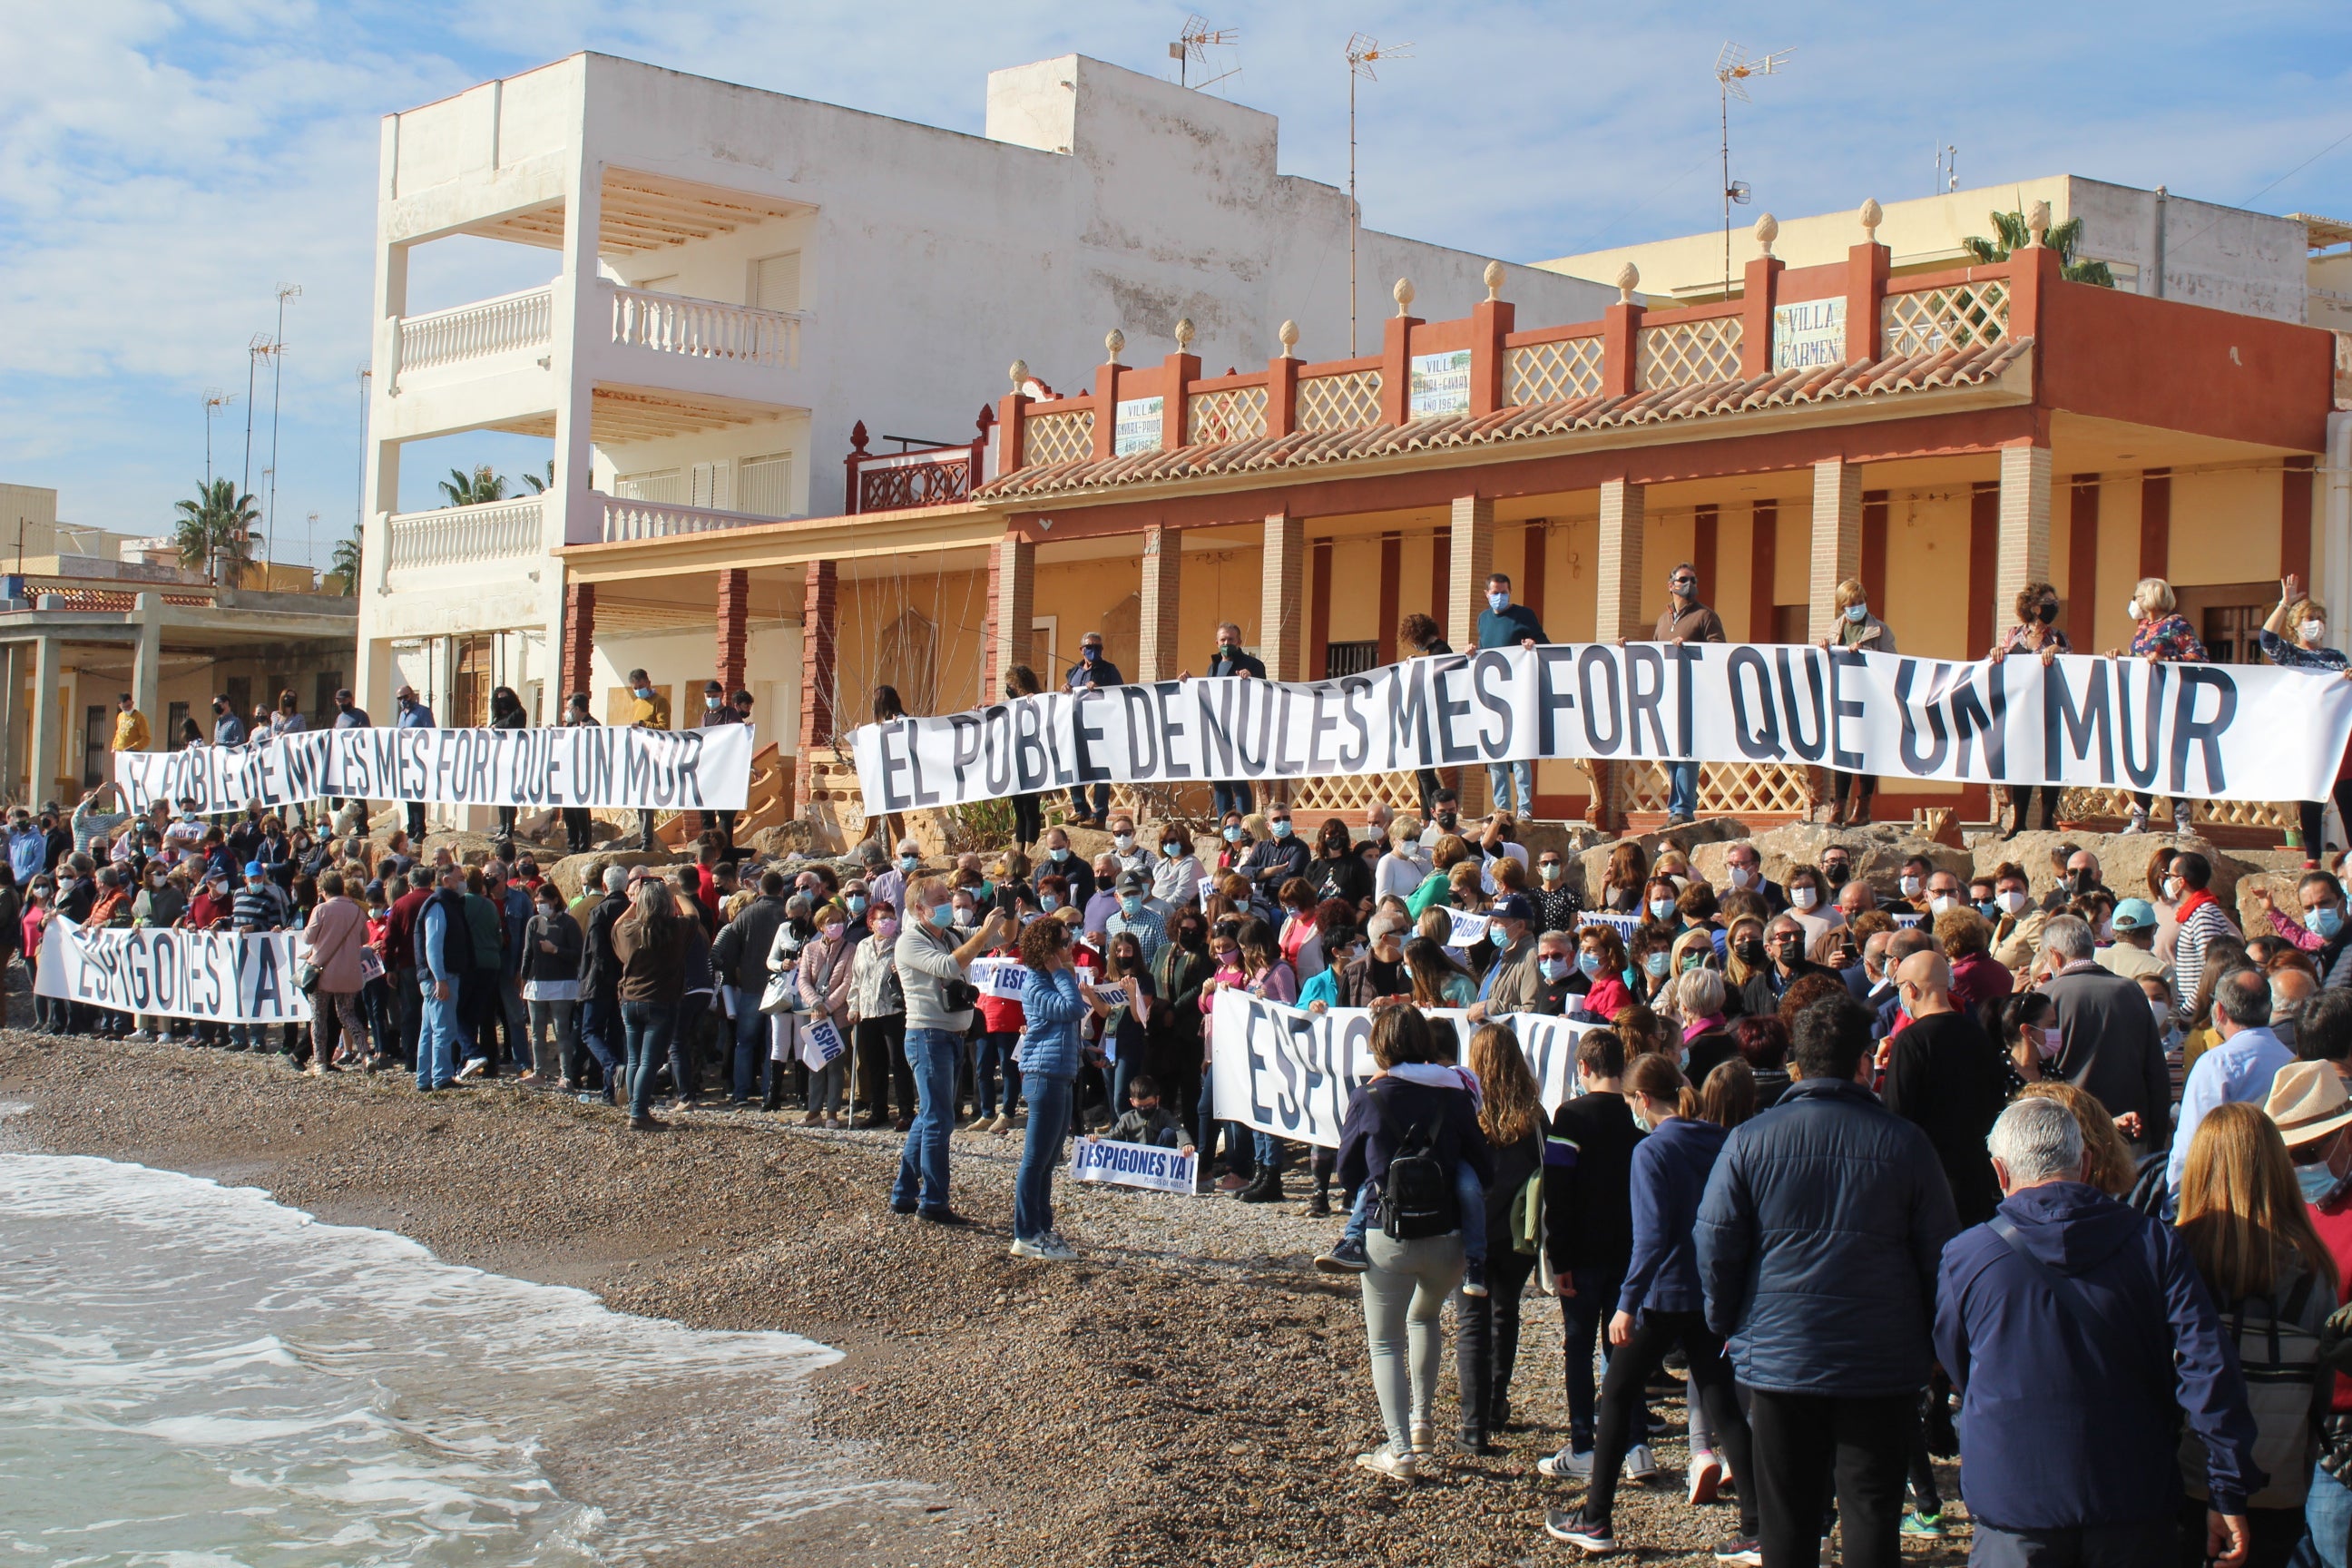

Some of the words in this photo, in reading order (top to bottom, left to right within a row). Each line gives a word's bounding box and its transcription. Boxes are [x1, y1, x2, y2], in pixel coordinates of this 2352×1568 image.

[1788, 303, 1836, 332] VILLA
[1426, 358, 1456, 373] VILLA
[1781, 338, 1838, 368] CARMEN
[1128, 403, 1153, 417] VILLA
[1438, 397, 1457, 411] 1962
[879, 719, 940, 811] EL
[946, 687, 1112, 801] POBLE
[1119, 682, 1191, 780] DE
[1197, 675, 1374, 778] NULES
[1387, 650, 1514, 769] MES
[1535, 644, 1704, 759] FORT
[1726, 645, 1870, 770] QUE
[1894, 659, 2007, 780] UN
[2043, 659, 2239, 795] MUR
[129, 753, 153, 815] EL
[161, 747, 240, 814] POBLE
[283, 729, 370, 801] NULES
[375, 728, 431, 800] MES
[436, 730, 508, 803] FORT
[510, 728, 565, 806] QUE
[573, 728, 615, 806] UN
[622, 727, 704, 808] MUR
